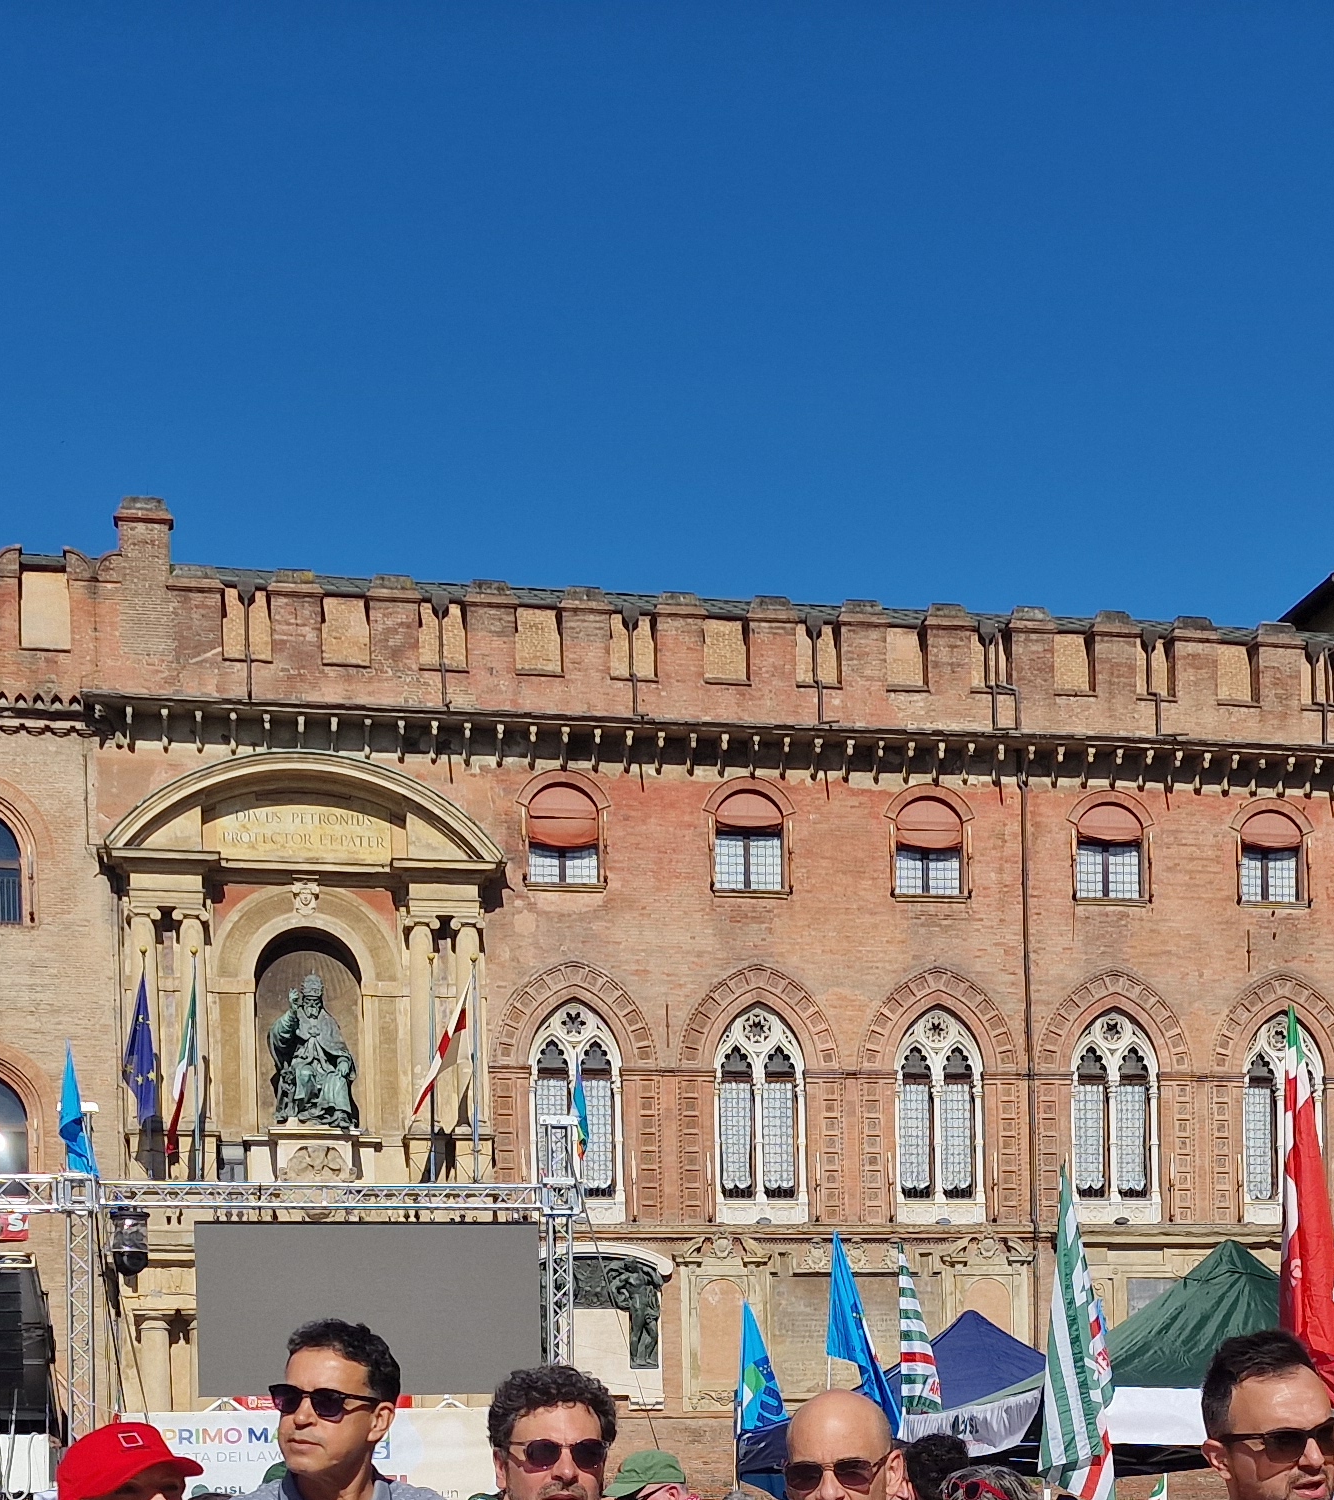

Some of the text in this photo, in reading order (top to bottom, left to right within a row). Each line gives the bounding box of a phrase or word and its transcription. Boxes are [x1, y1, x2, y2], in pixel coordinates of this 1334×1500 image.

[235, 810, 373, 826] DIVUS PETRONIUS
[222, 831, 314, 846] PROTECTOR
[340, 835, 386, 849] PATER
[162, 1427, 243, 1445] PRIMO
[216, 1451, 242, 1463] DEI
